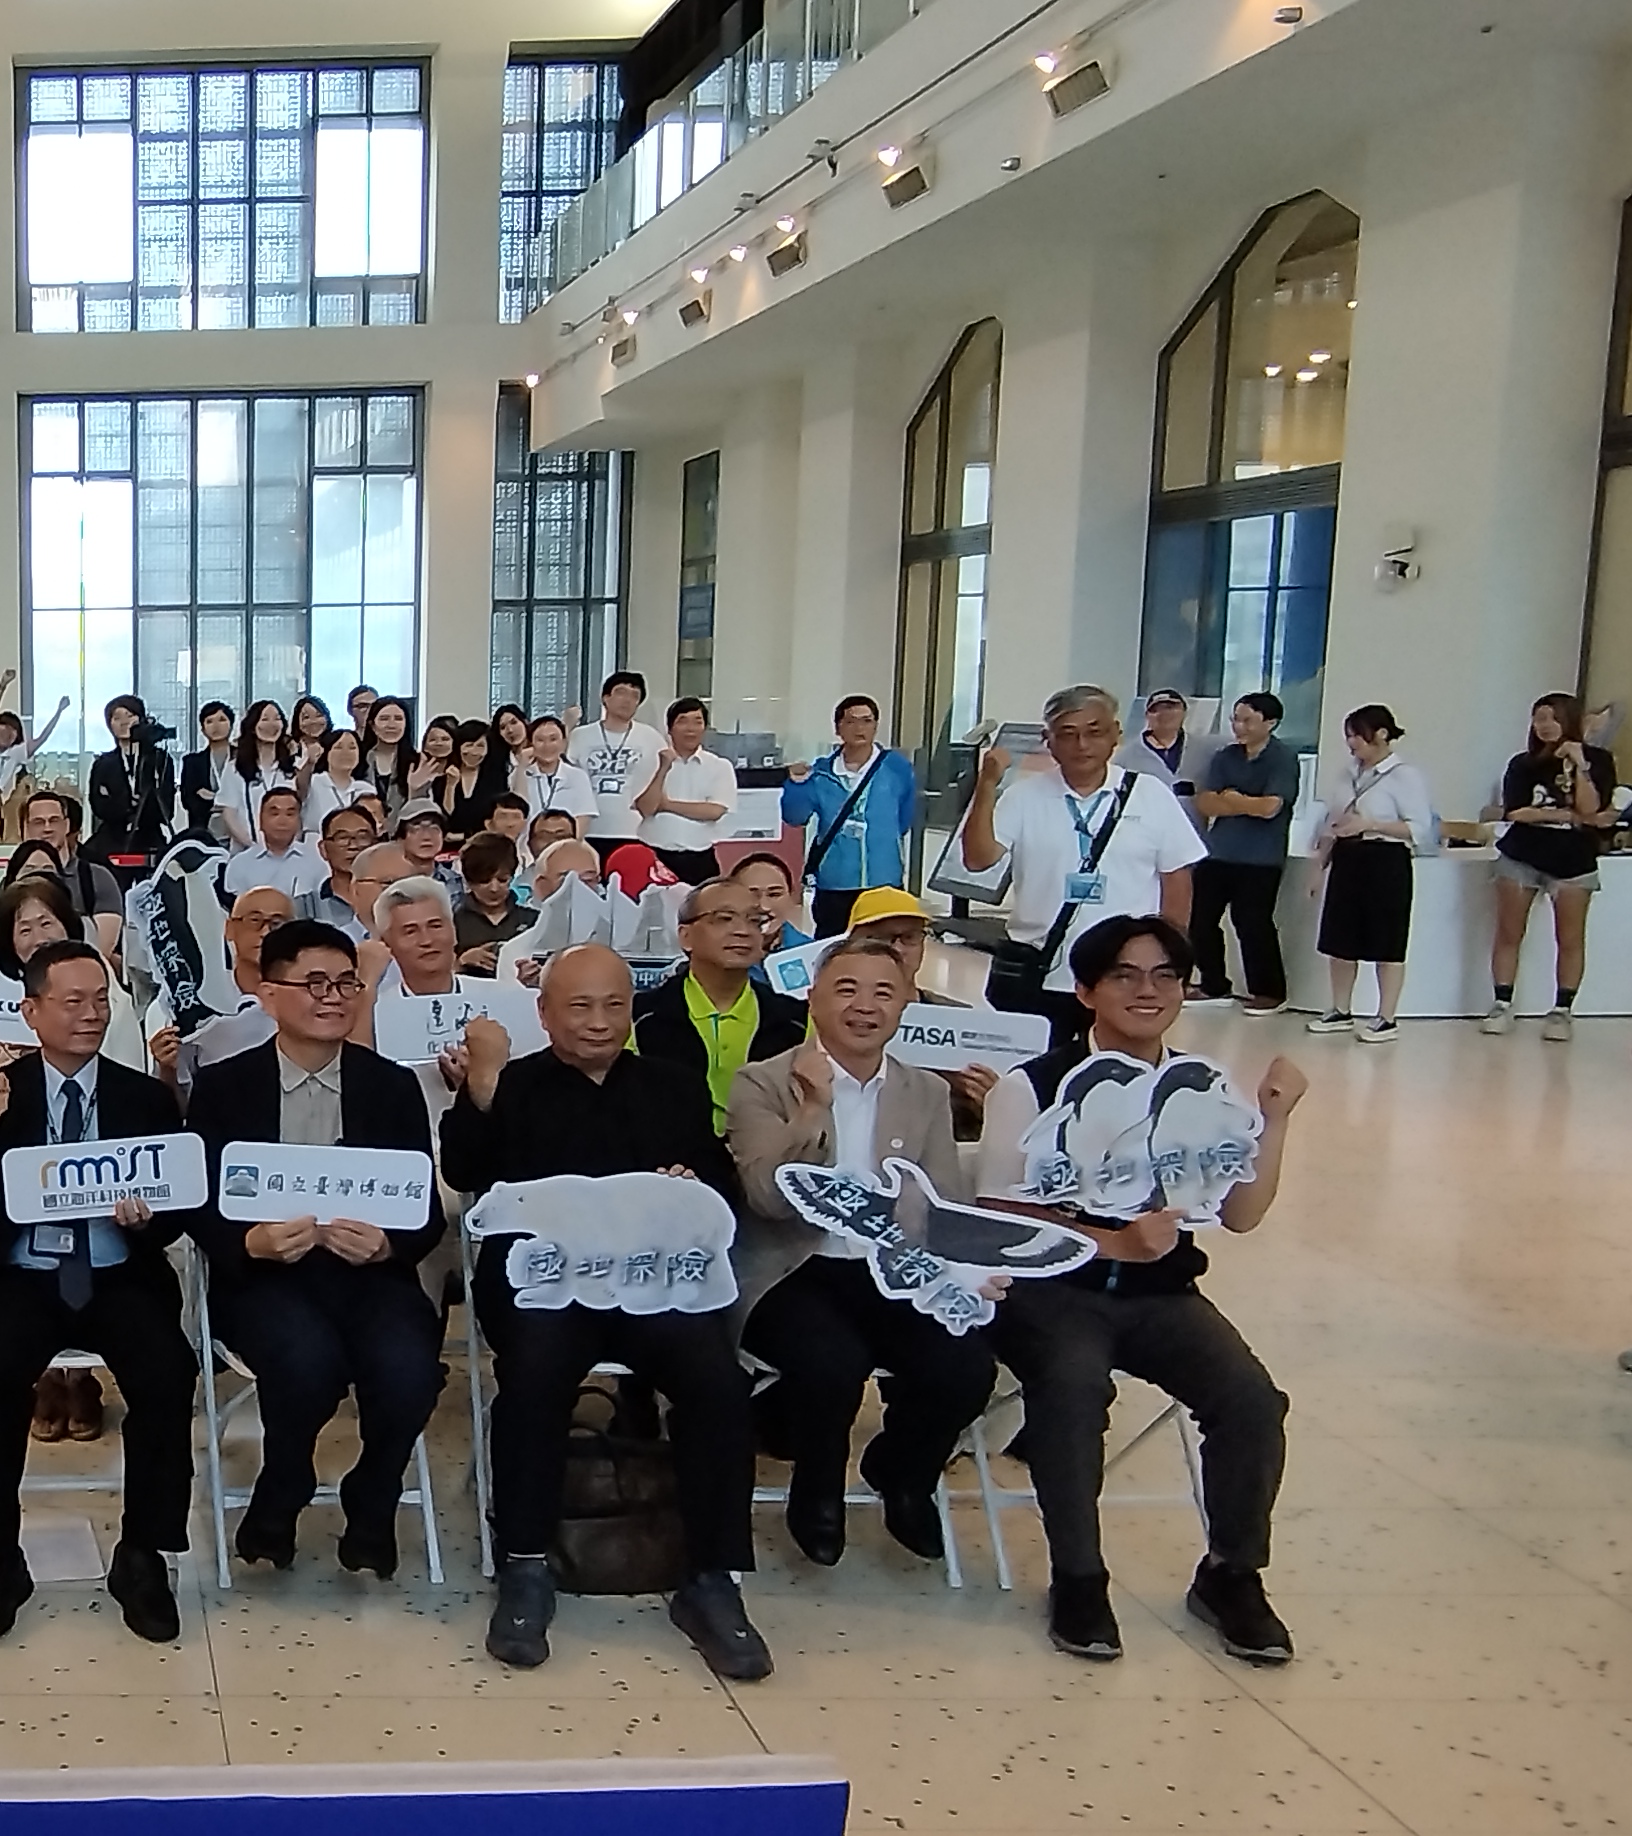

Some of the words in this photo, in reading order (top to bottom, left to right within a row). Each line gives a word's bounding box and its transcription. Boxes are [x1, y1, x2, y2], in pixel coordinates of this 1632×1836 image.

[900, 1024, 956, 1048] TASA
[267, 1173, 425, 1199] 國立臺灣博物館
[526, 1243, 713, 1288] 極地探險
[817, 1176, 982, 1325] 極地探險
